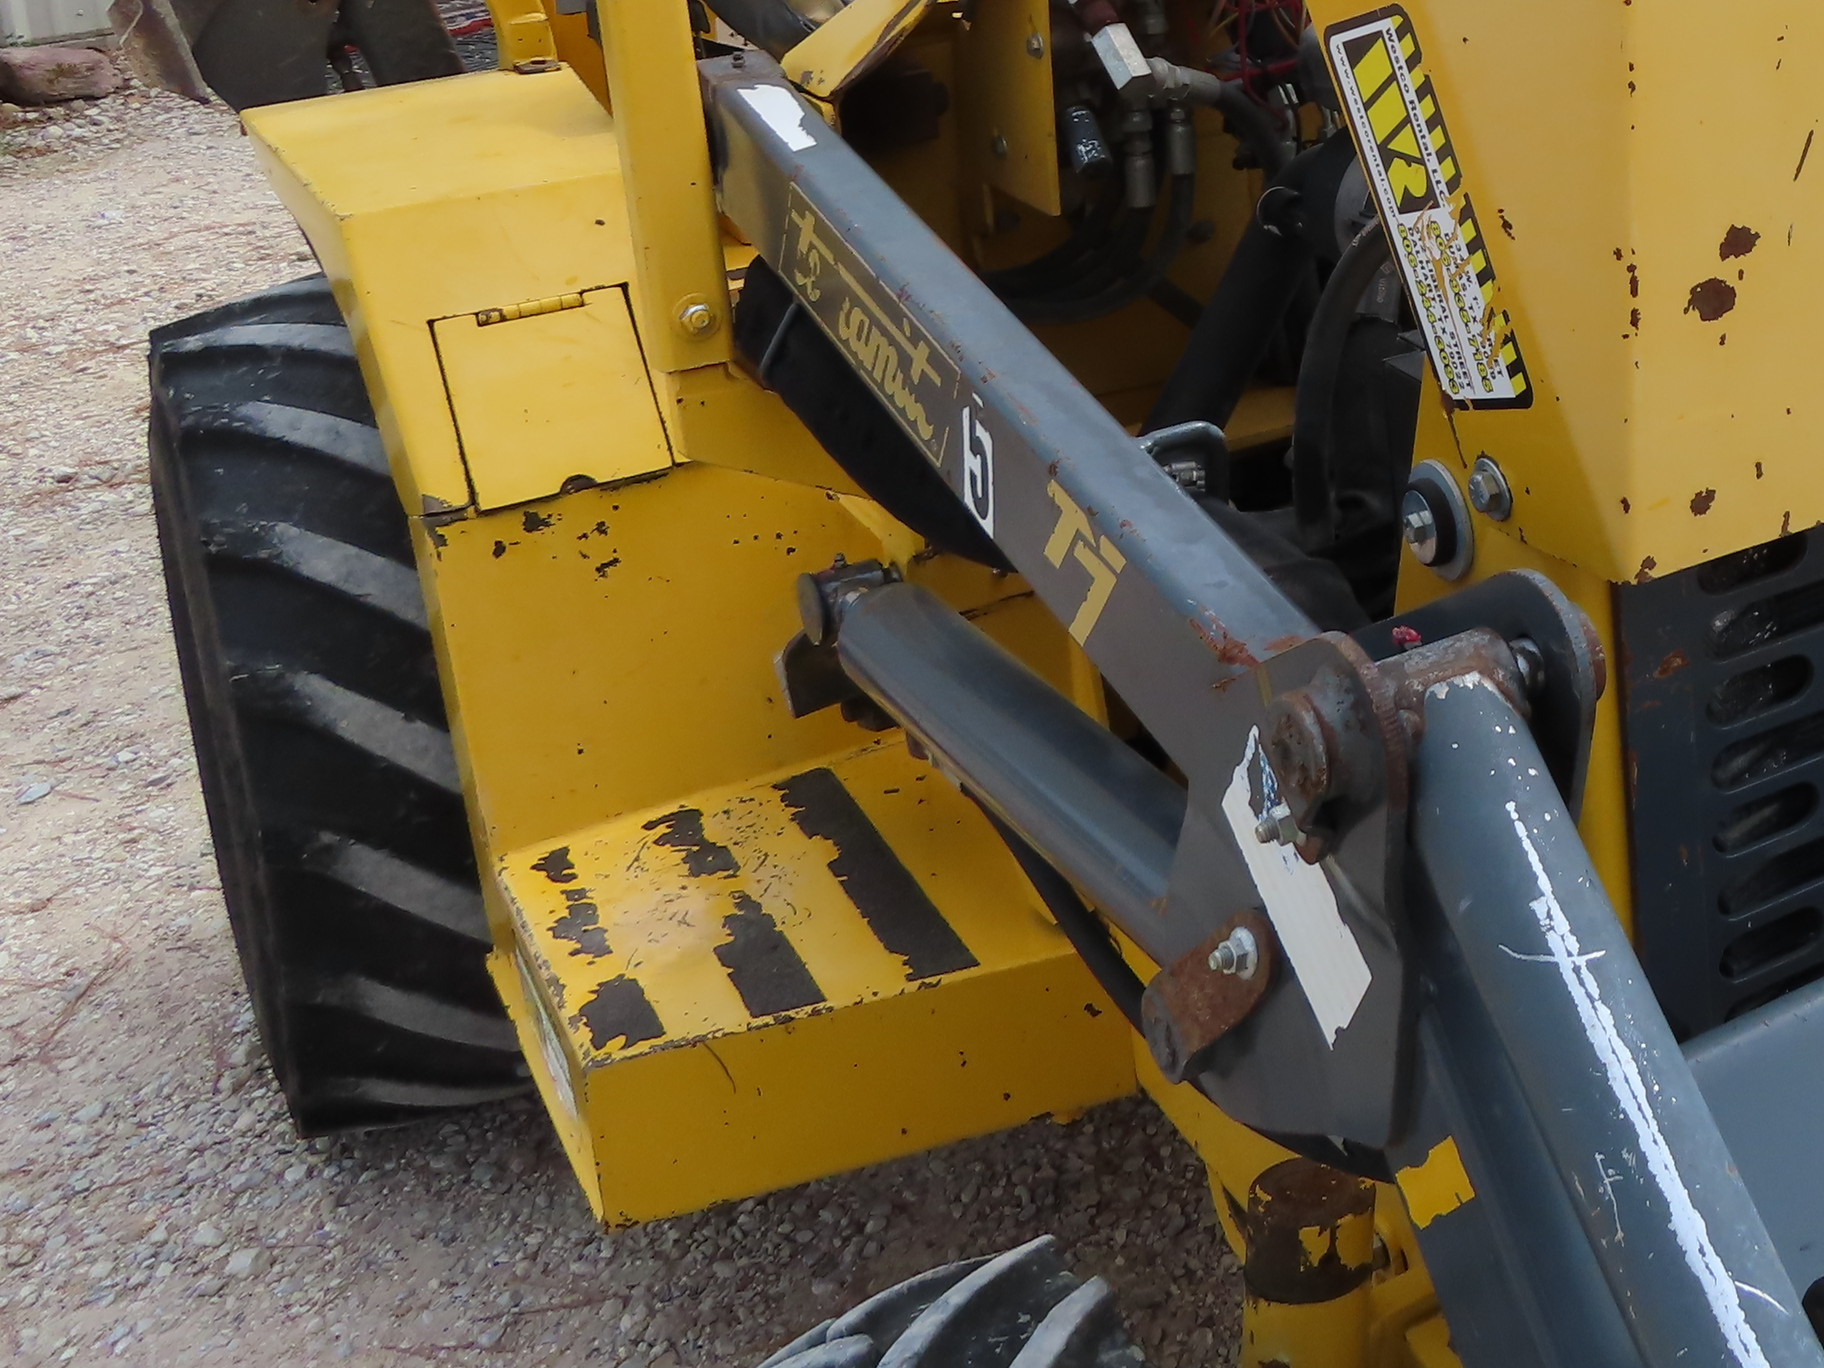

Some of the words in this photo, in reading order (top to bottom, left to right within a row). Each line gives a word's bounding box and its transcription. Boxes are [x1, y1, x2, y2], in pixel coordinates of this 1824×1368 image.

[1383, 26, 1411, 94] Westco
[1466, 303, 1479, 324] TX
[1435, 314, 1447, 335] TX
